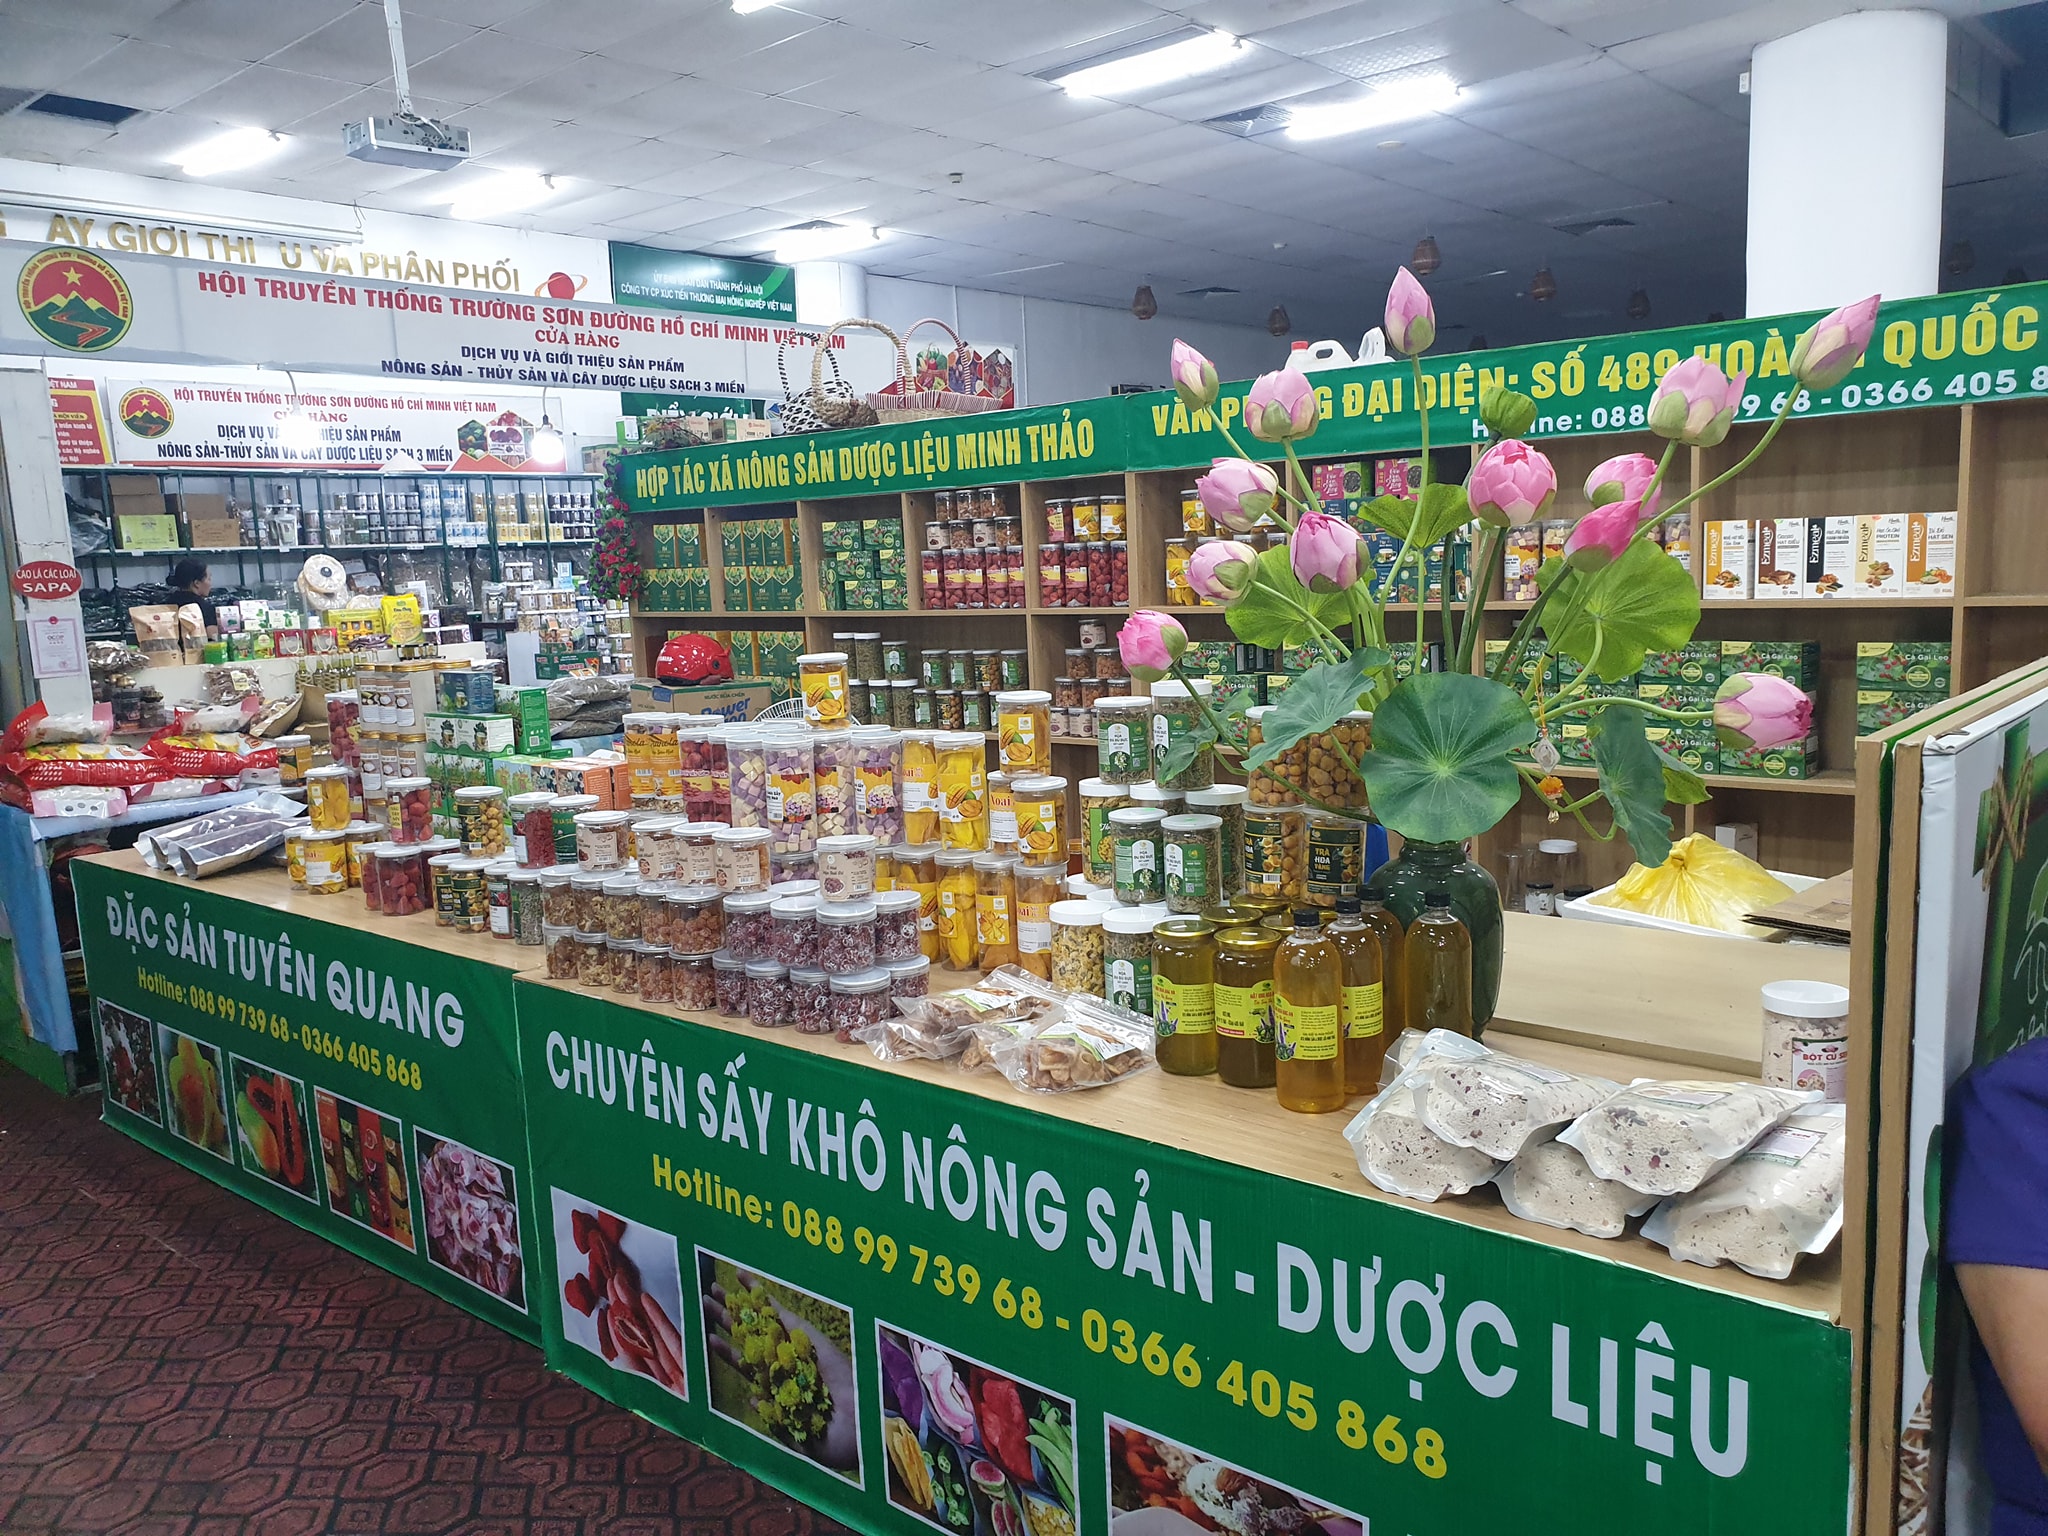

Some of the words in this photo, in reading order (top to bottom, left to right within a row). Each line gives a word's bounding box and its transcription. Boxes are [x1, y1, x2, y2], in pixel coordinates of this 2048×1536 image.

[360, 250, 445, 284] PHÂN
[452, 258, 520, 292] PHỐI
[621, 282, 641, 295] CÔNG
[641, 286, 650, 295] TY
[199, 270, 246, 298] HỘI
[364, 287, 443, 314] THỐNG
[450, 298, 536, 322] TRƯỜNG
[542, 306, 584, 327] SƠN
[590, 310, 655, 333] ĐƯỜNG
[691, 320, 719, 339] CHÍ
[725, 325, 768, 343] MINH
[535, 326, 570, 345] CỬA
[574, 330, 620, 349] HÀNG
[461, 345, 496, 361] DỊCH
[501, 348, 518, 364] VỤ
[523, 349, 541, 363] VÀ
[546, 350, 573, 366] GIỚI
[577, 353, 614, 370] THIỆU
[618, 355, 645, 371] SẢN
[649, 356, 685, 373] PHẨM
[1342, 377, 1403, 423] ĐẠI
[1531, 344, 1588, 399] SỐ
[1597, 349, 1680, 393] 489
[1883, 293, 2039, 368] QUỐC
[381, 359, 426, 376] NÔNG
[431, 363, 463, 377] SẢN
[477, 364, 513, 380] THỦY
[518, 366, 547, 382] SẢN
[551, 369, 569, 384] VÀ
[572, 371, 597, 386] CÂY
[602, 374, 636, 389] DƯỢC
[640, 375, 664, 390] LIỆU
[669, 378, 702, 394] SẠCH
[704, 381, 712, 392] 3
[173, 386, 195, 404] HỘI
[245, 388, 282, 405] THỐNG
[330, 394, 351, 408] SƠN
[354, 396, 389, 410] ĐƯỜNG
[407, 397, 424, 411] CHÍ
[426, 399, 451, 412] MINH
[453, 399, 473, 414] VIỆT
[475, 402, 497, 413] NAM
[1591, 406, 1646, 428] 088
[1770, 389, 1811, 414] 68
[1842, 377, 1934, 408] 0366
[1944, 368, 2017, 398] 405
[308, 410, 348, 423] HÀNG
[217, 424, 246, 441] DỊCH
[250, 425, 264, 442] VỤ
[346, 425, 368, 442] SẢN
[371, 425, 402, 443] PHẨM
[157, 441, 192, 458] NÔNG
[256, 442, 279, 460] SẢN
[326, 446, 356, 464] DƯỢC
[359, 445, 383, 465] LIỆU
[417, 449, 423, 461] 3
[636, 462, 669, 504] HỢP
[672, 457, 705, 495] TÁC
[708, 454, 734, 492] XÃ
[736, 450, 791, 490] NÔNG
[794, 440, 835, 485] SẢN
[839, 441, 897, 486] DƯỢC
[901, 431, 951, 481] LIỆU
[956, 427, 1021, 470] MINH
[1026, 408, 1095, 464] THẢO
[16, 569, 31, 579] CAO
[22, 582, 72, 593] SAPA
[1761, 652, 1771, 660] Cà
[1772, 653, 1784, 661] Gai
[1905, 653, 1916, 661] Cà
[1917, 653, 1930, 661] Gai
[1905, 701, 1916, 709] Cà
[106, 890, 159, 955] ĐẶC
[164, 902, 217, 970] SẢN
[223, 932, 316, 1002] TUYÊN
[326, 960, 465, 1048] QUANG
[137, 966, 188, 1005] Hotline:
[189, 984, 216, 1015] 088
[217, 995, 237, 1022] 99
[239, 1001, 267, 1034] 739
[270, 1013, 290, 1042] 68
[293, 1031, 299, 1040] -
[302, 1024, 344, 1063] 0366
[348, 1041, 382, 1077] 405
[386, 1053, 422, 1091] 868
[546, 1030, 687, 1129] CHUYÊN
[697, 1052, 773, 1156] SẤY
[787, 1098, 887, 1192] KHÔ
[902, 1123, 1068, 1251] NÔNG
[1086, 1168, 1213, 1304] SẢN
[1235, 1270, 1255, 1295] -
[1276, 1241, 1519, 1402] DƯỢC
[1551, 1320, 1750, 1487] LIỆU
[652, 1153, 774, 1229] Hotline:
[782, 1200, 845, 1254] 088
[853, 1226, 898, 1273] 99
[909, 1244, 981, 1305] 739
[992, 1277, 1044, 1330] 68
[1055, 1315, 1071, 1331] -
[1081, 1308, 1203, 1386] 0366
[1216, 1359, 1318, 1431] 405
[1336, 1398, 1448, 1480] 868
